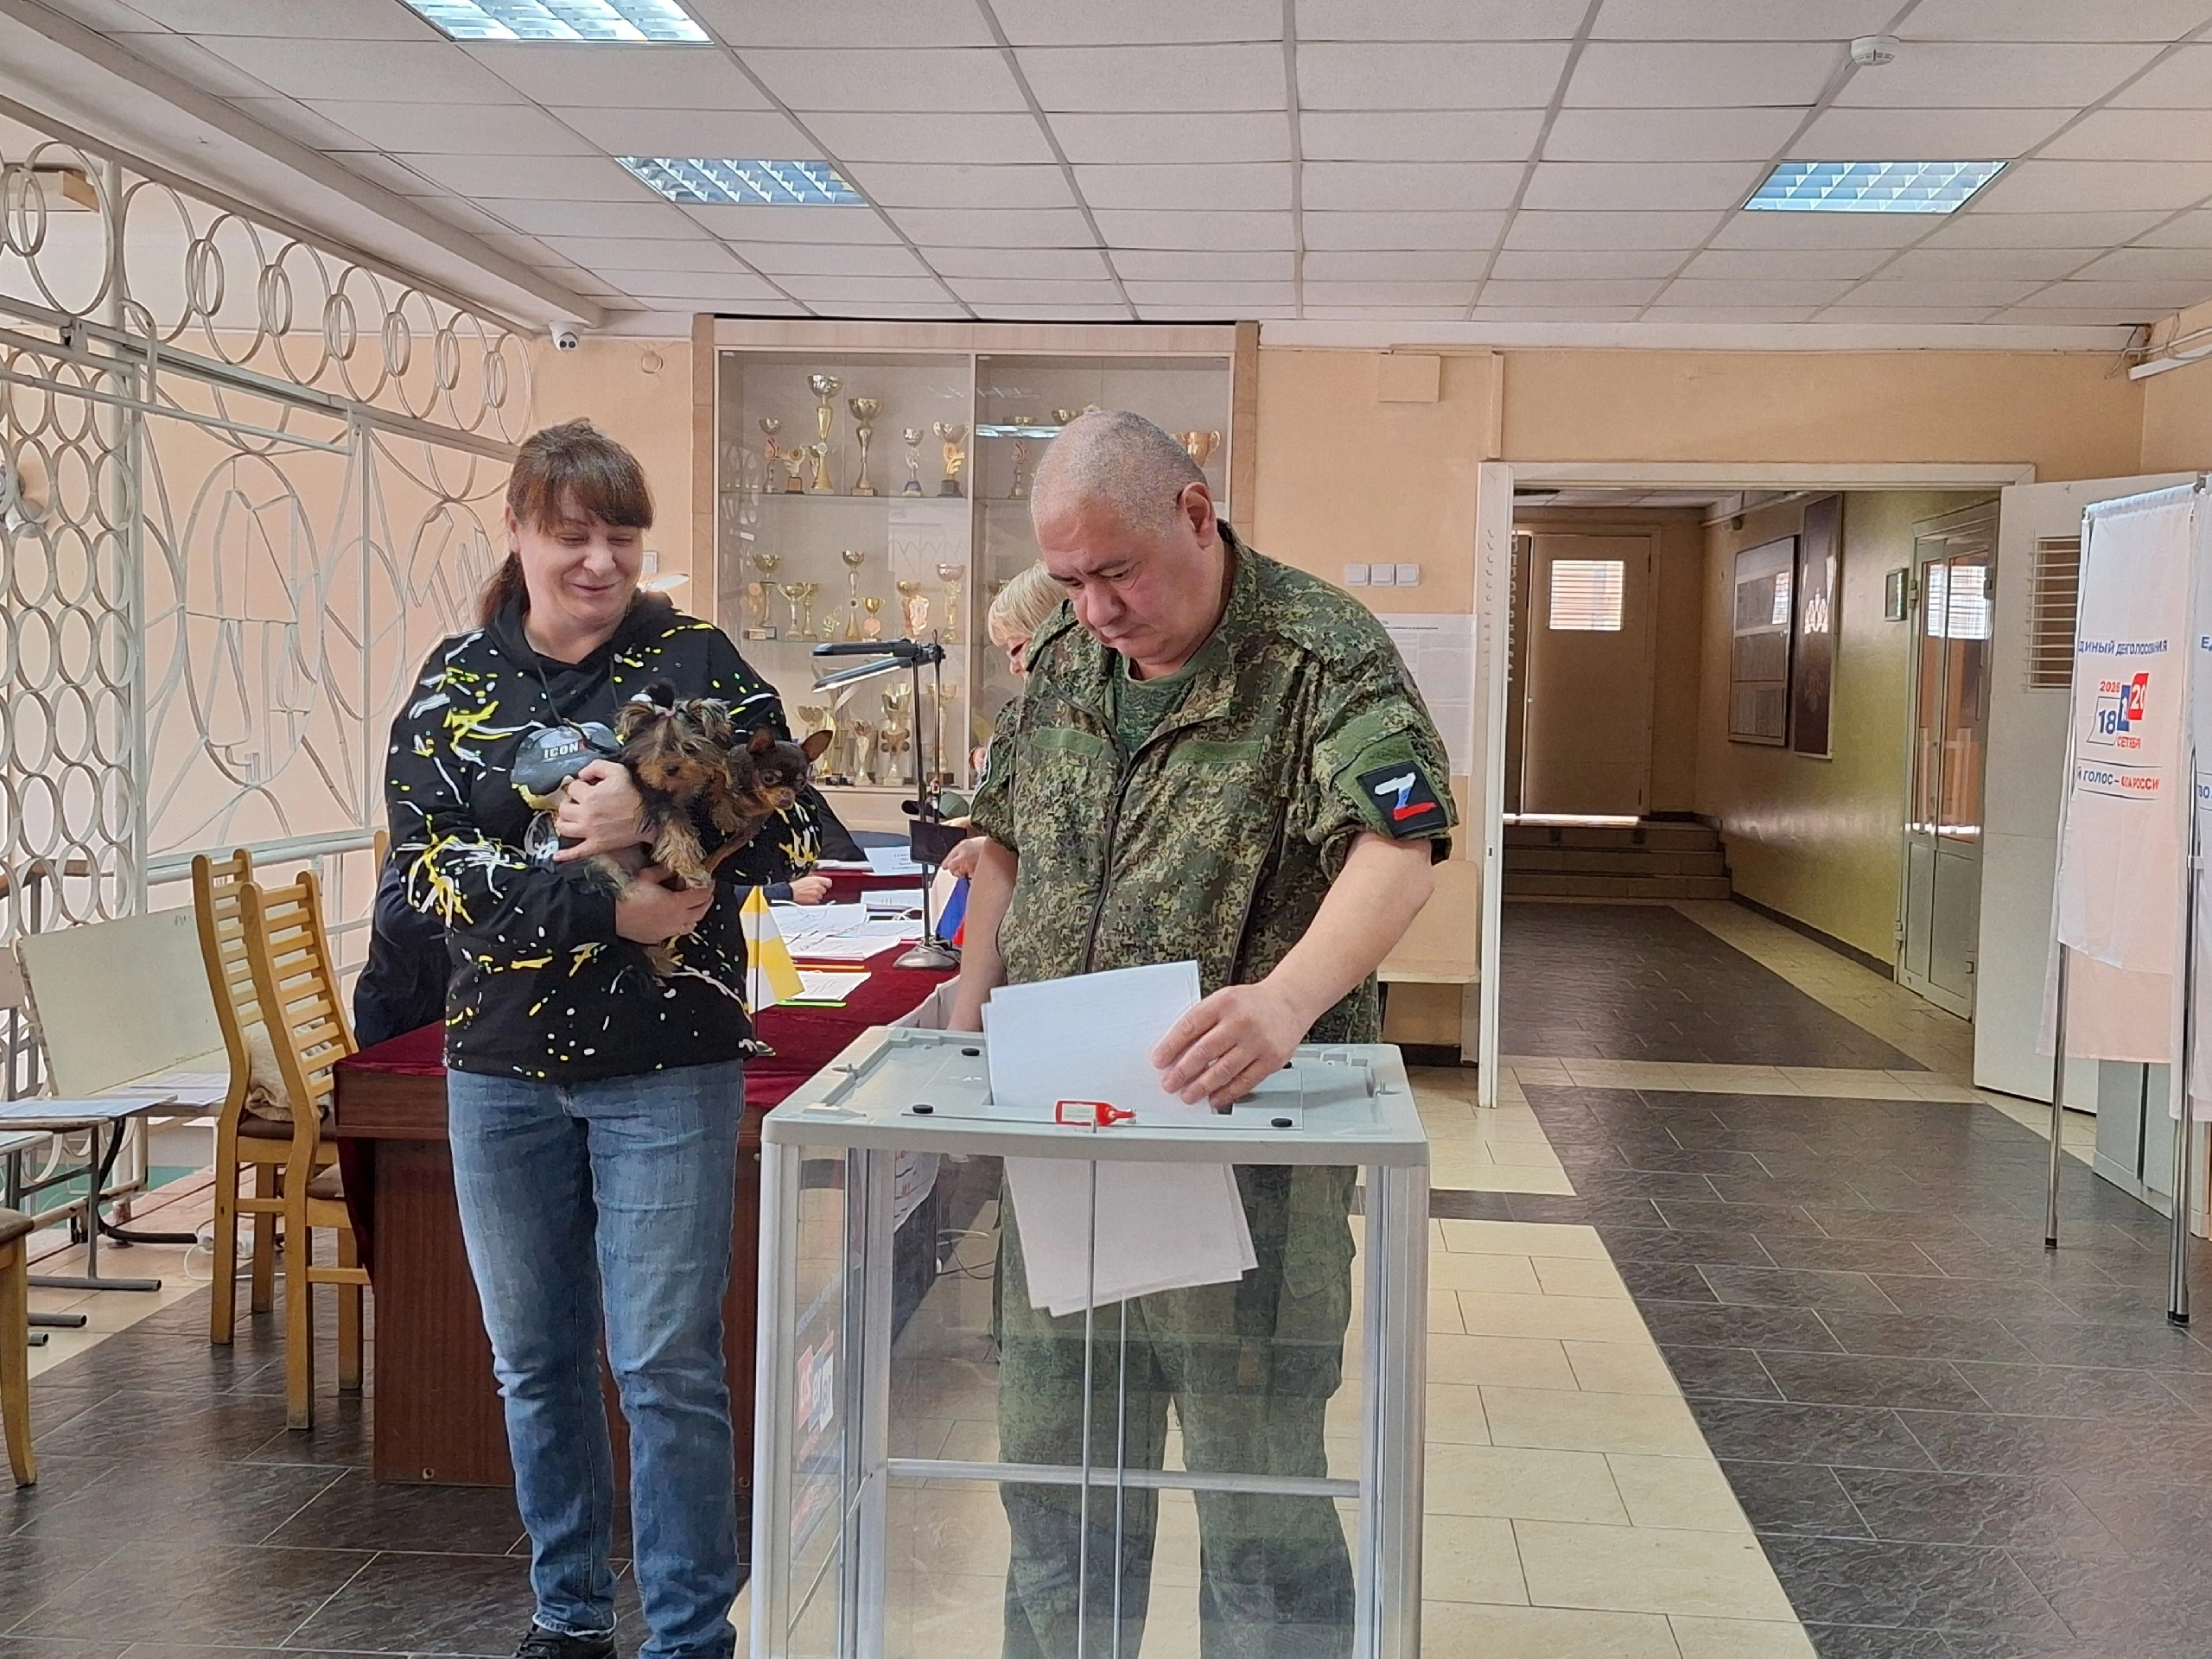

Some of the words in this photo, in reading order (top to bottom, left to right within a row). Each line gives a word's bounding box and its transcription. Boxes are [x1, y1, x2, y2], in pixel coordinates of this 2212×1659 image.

[2078, 640, 2115, 654] ДИНЫЙ
[2098, 709, 2117, 734] 18
[543, 741, 579, 759] ICON
[2083, 770, 2113, 785] ГОЛОС
